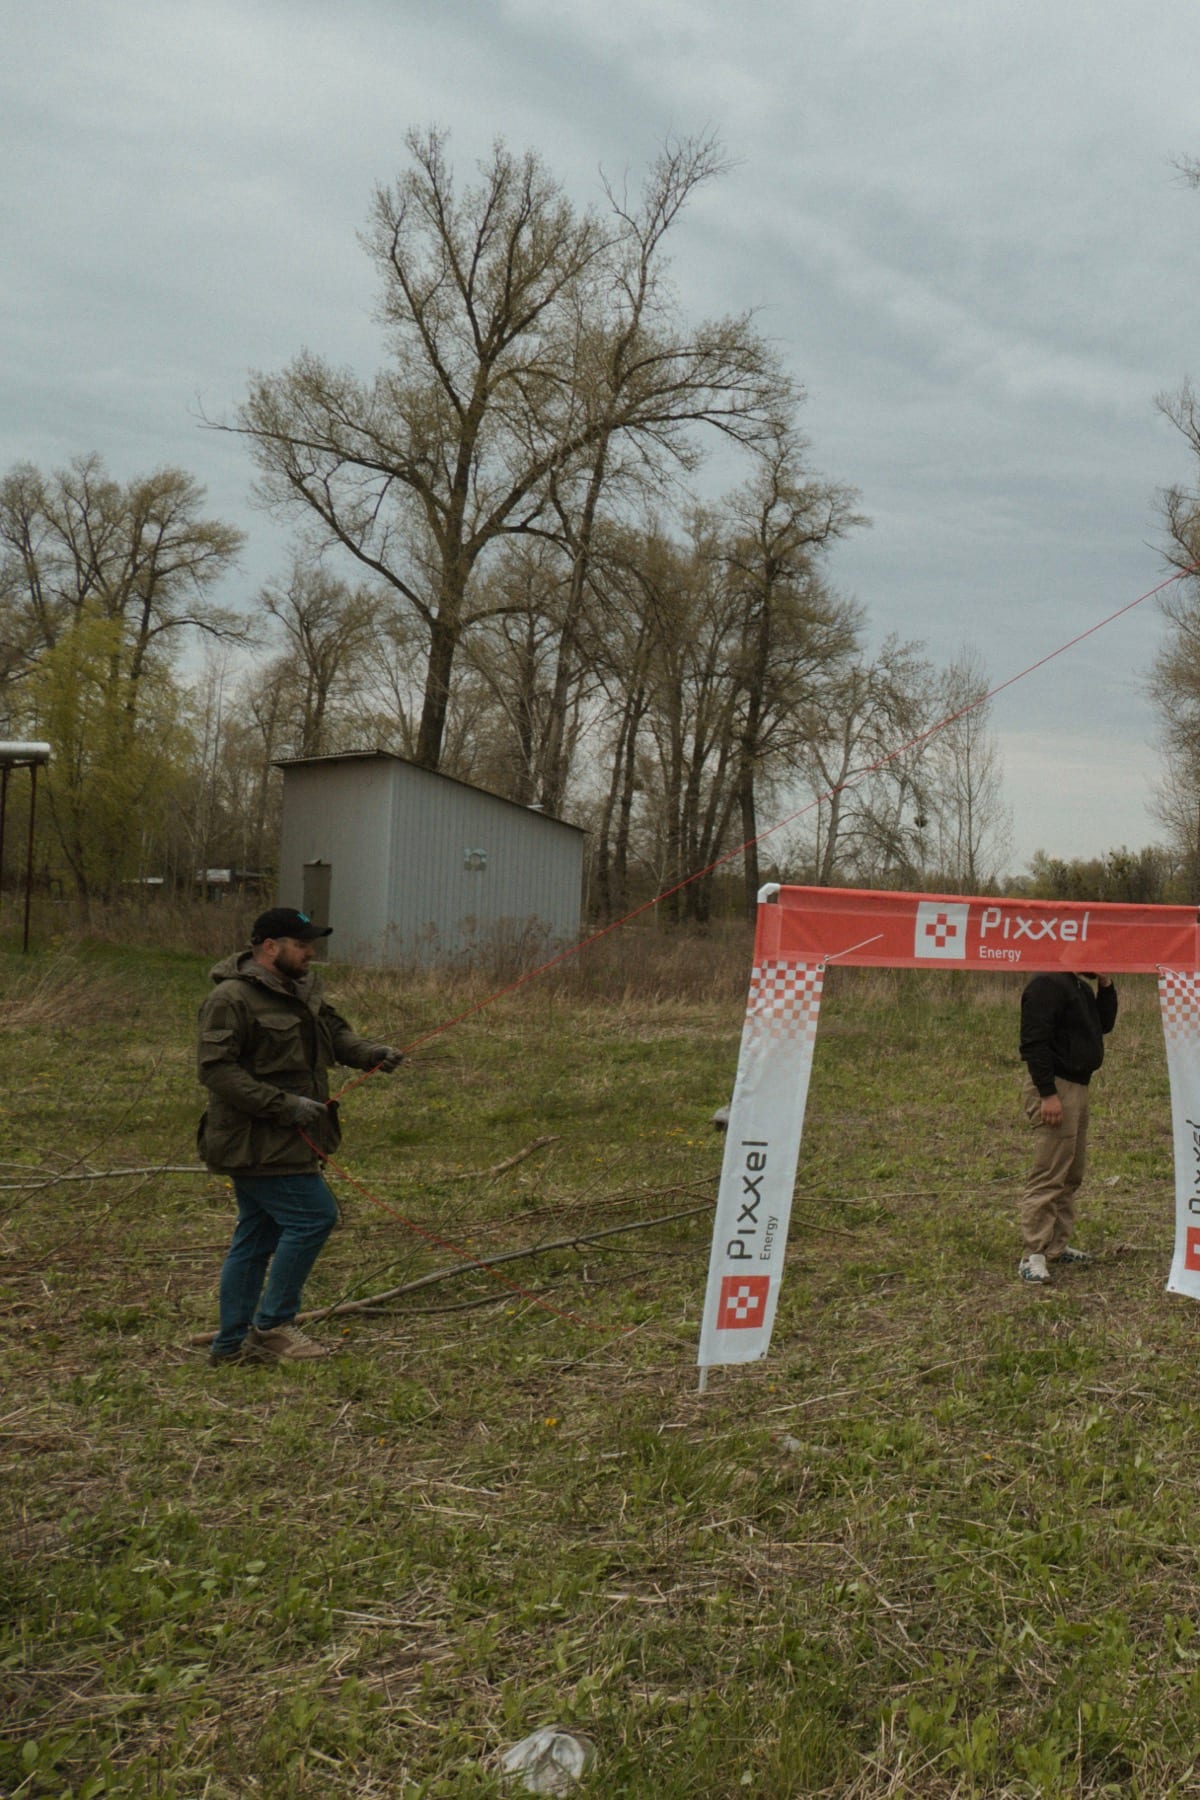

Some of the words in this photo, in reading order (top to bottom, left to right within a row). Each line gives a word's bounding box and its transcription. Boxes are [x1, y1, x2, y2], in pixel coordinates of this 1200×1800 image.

[979, 907, 1089, 942] Pixxel
[979, 946, 1022, 962] Energy
[727, 1141, 768, 1260] Pixxel
[760, 1215, 779, 1261] Energy
